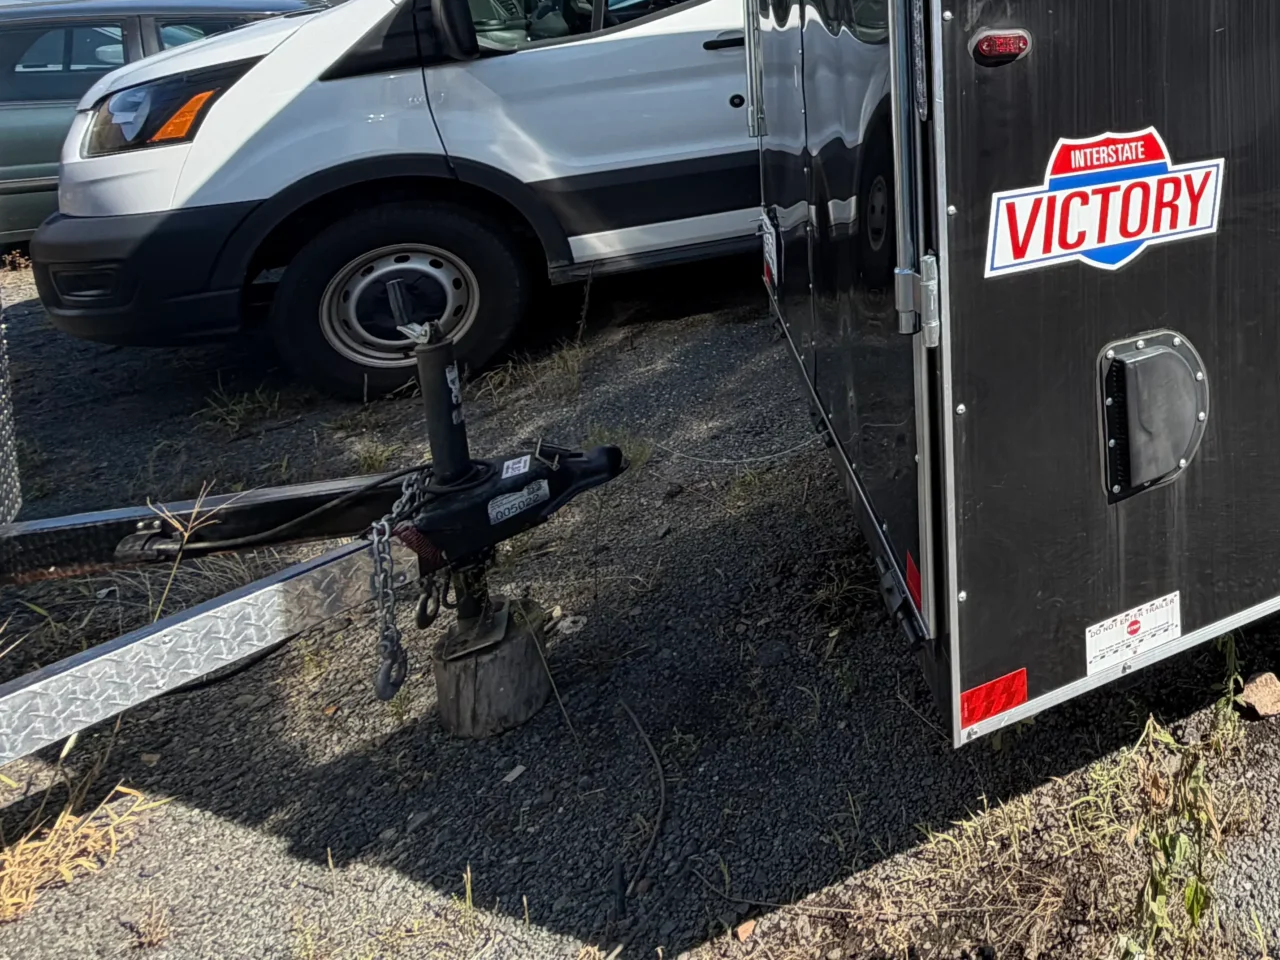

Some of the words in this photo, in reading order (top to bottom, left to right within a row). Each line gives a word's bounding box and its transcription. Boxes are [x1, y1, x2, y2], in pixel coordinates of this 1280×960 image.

[1071, 141, 1146, 169] INTERSTATE
[1005, 170, 1213, 261] VICTORY
[1090, 628, 1102, 638] DO
[1103, 621, 1119, 632] NOT
[1120, 611, 1144, 625] ENTER
[1145, 598, 1175, 615] TRAILER
